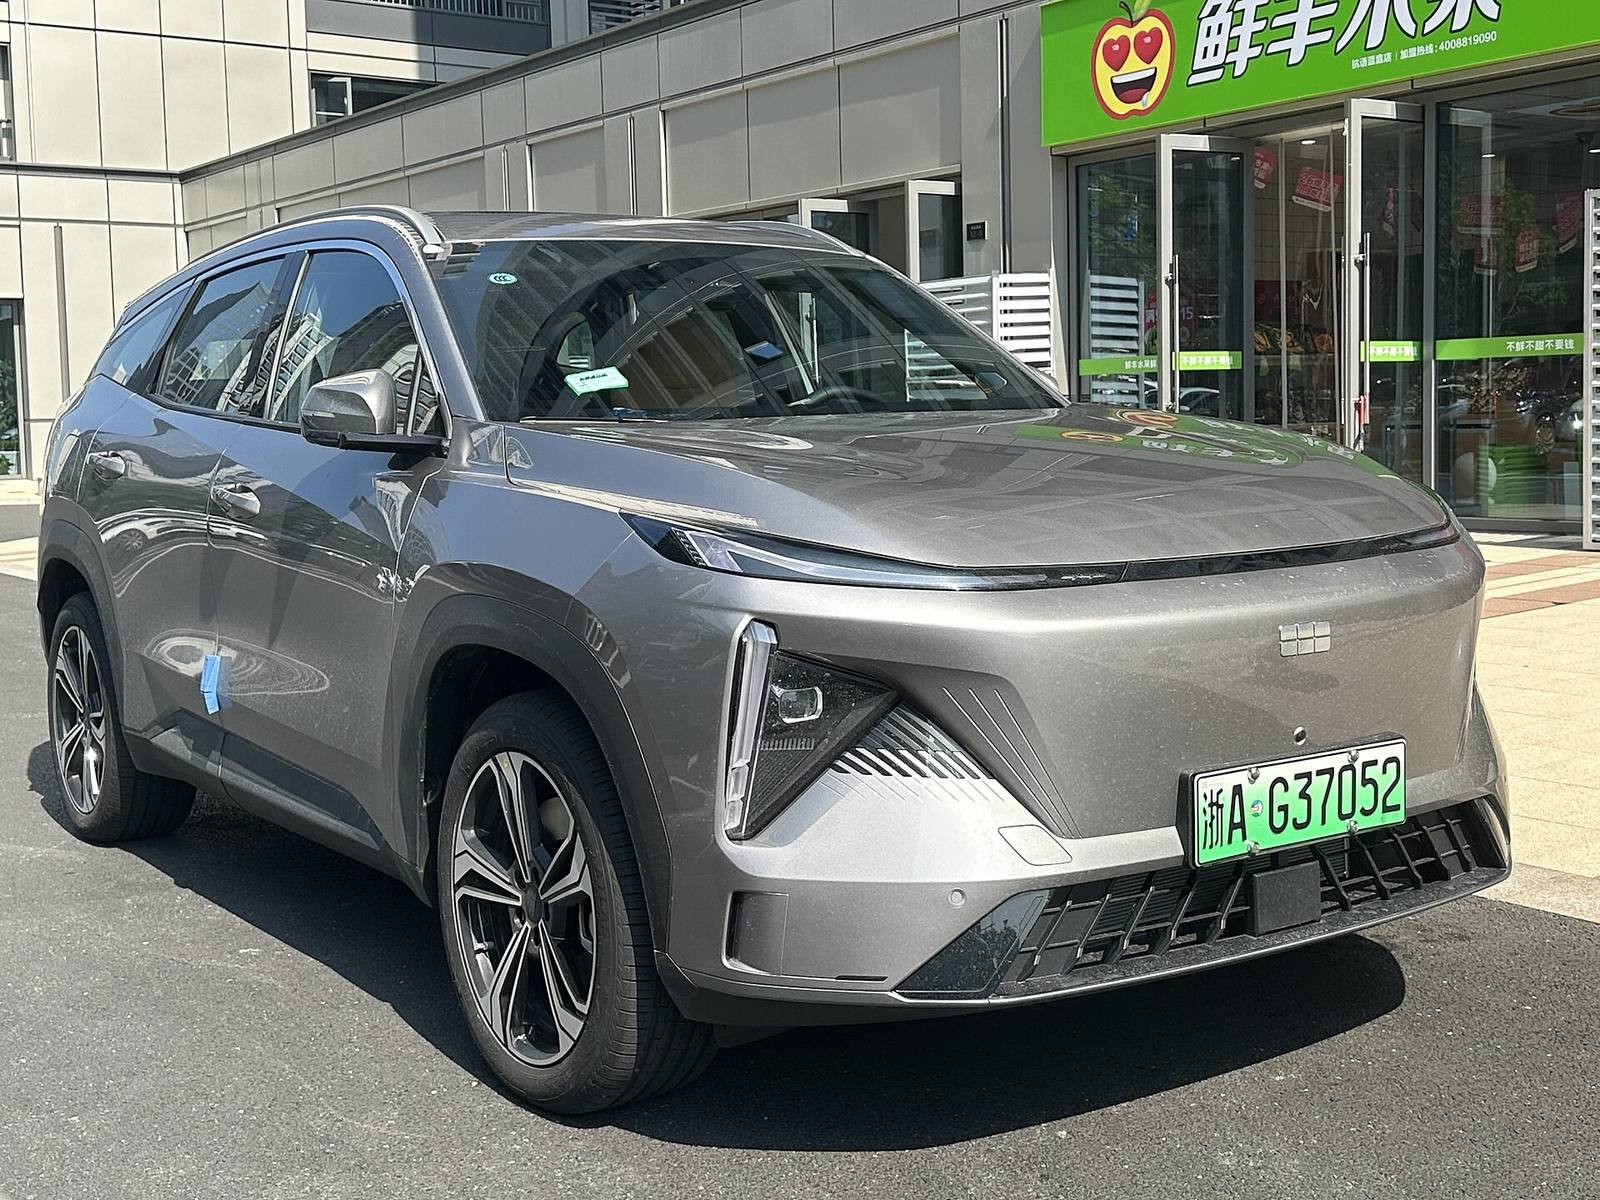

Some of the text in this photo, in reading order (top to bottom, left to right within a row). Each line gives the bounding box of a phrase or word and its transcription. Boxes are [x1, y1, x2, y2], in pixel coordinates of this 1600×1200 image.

[1506, 338, 1575, 352] 不鲜不甜不要钱
[1268, 756, 1401, 834] G37052
